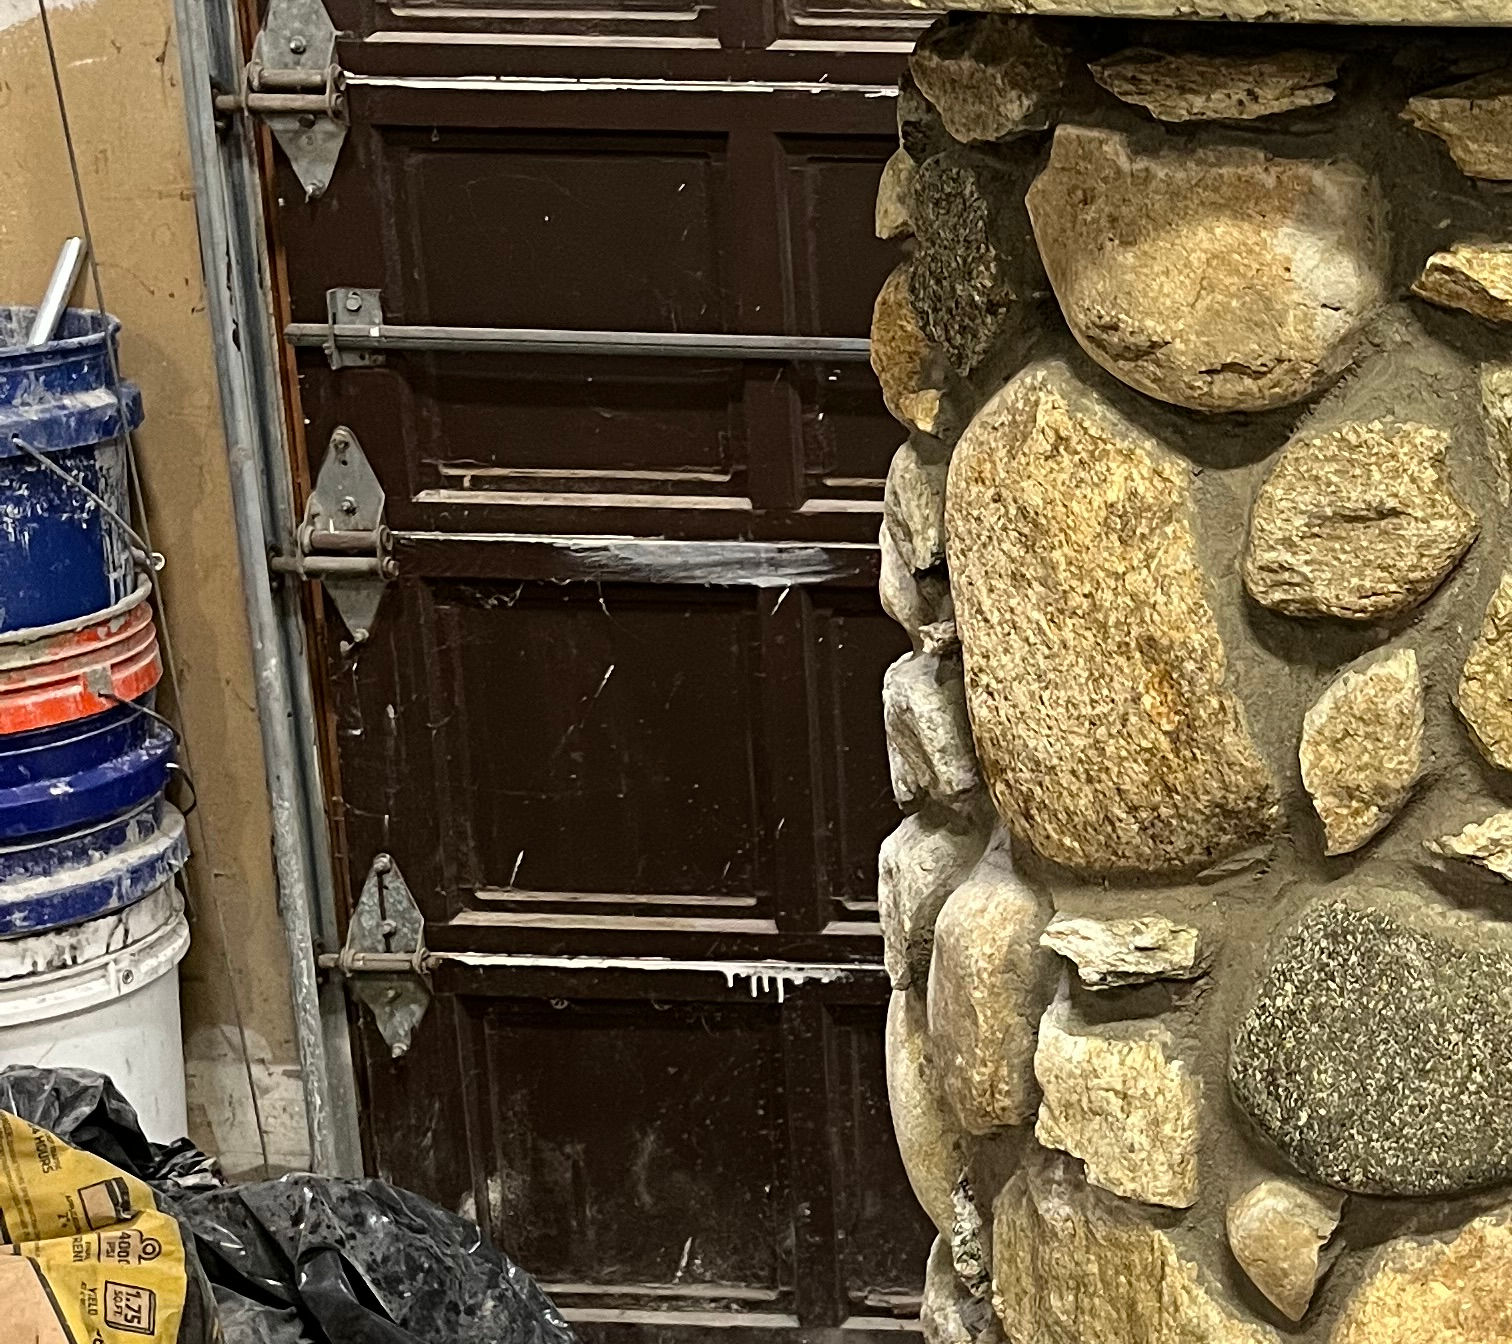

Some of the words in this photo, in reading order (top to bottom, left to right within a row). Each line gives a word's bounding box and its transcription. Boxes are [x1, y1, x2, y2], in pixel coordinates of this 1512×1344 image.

[34, 1135, 51, 1175] HOURS
[88, 1287, 98, 1316] YIELD
[124, 1290, 142, 1325] 1.75
